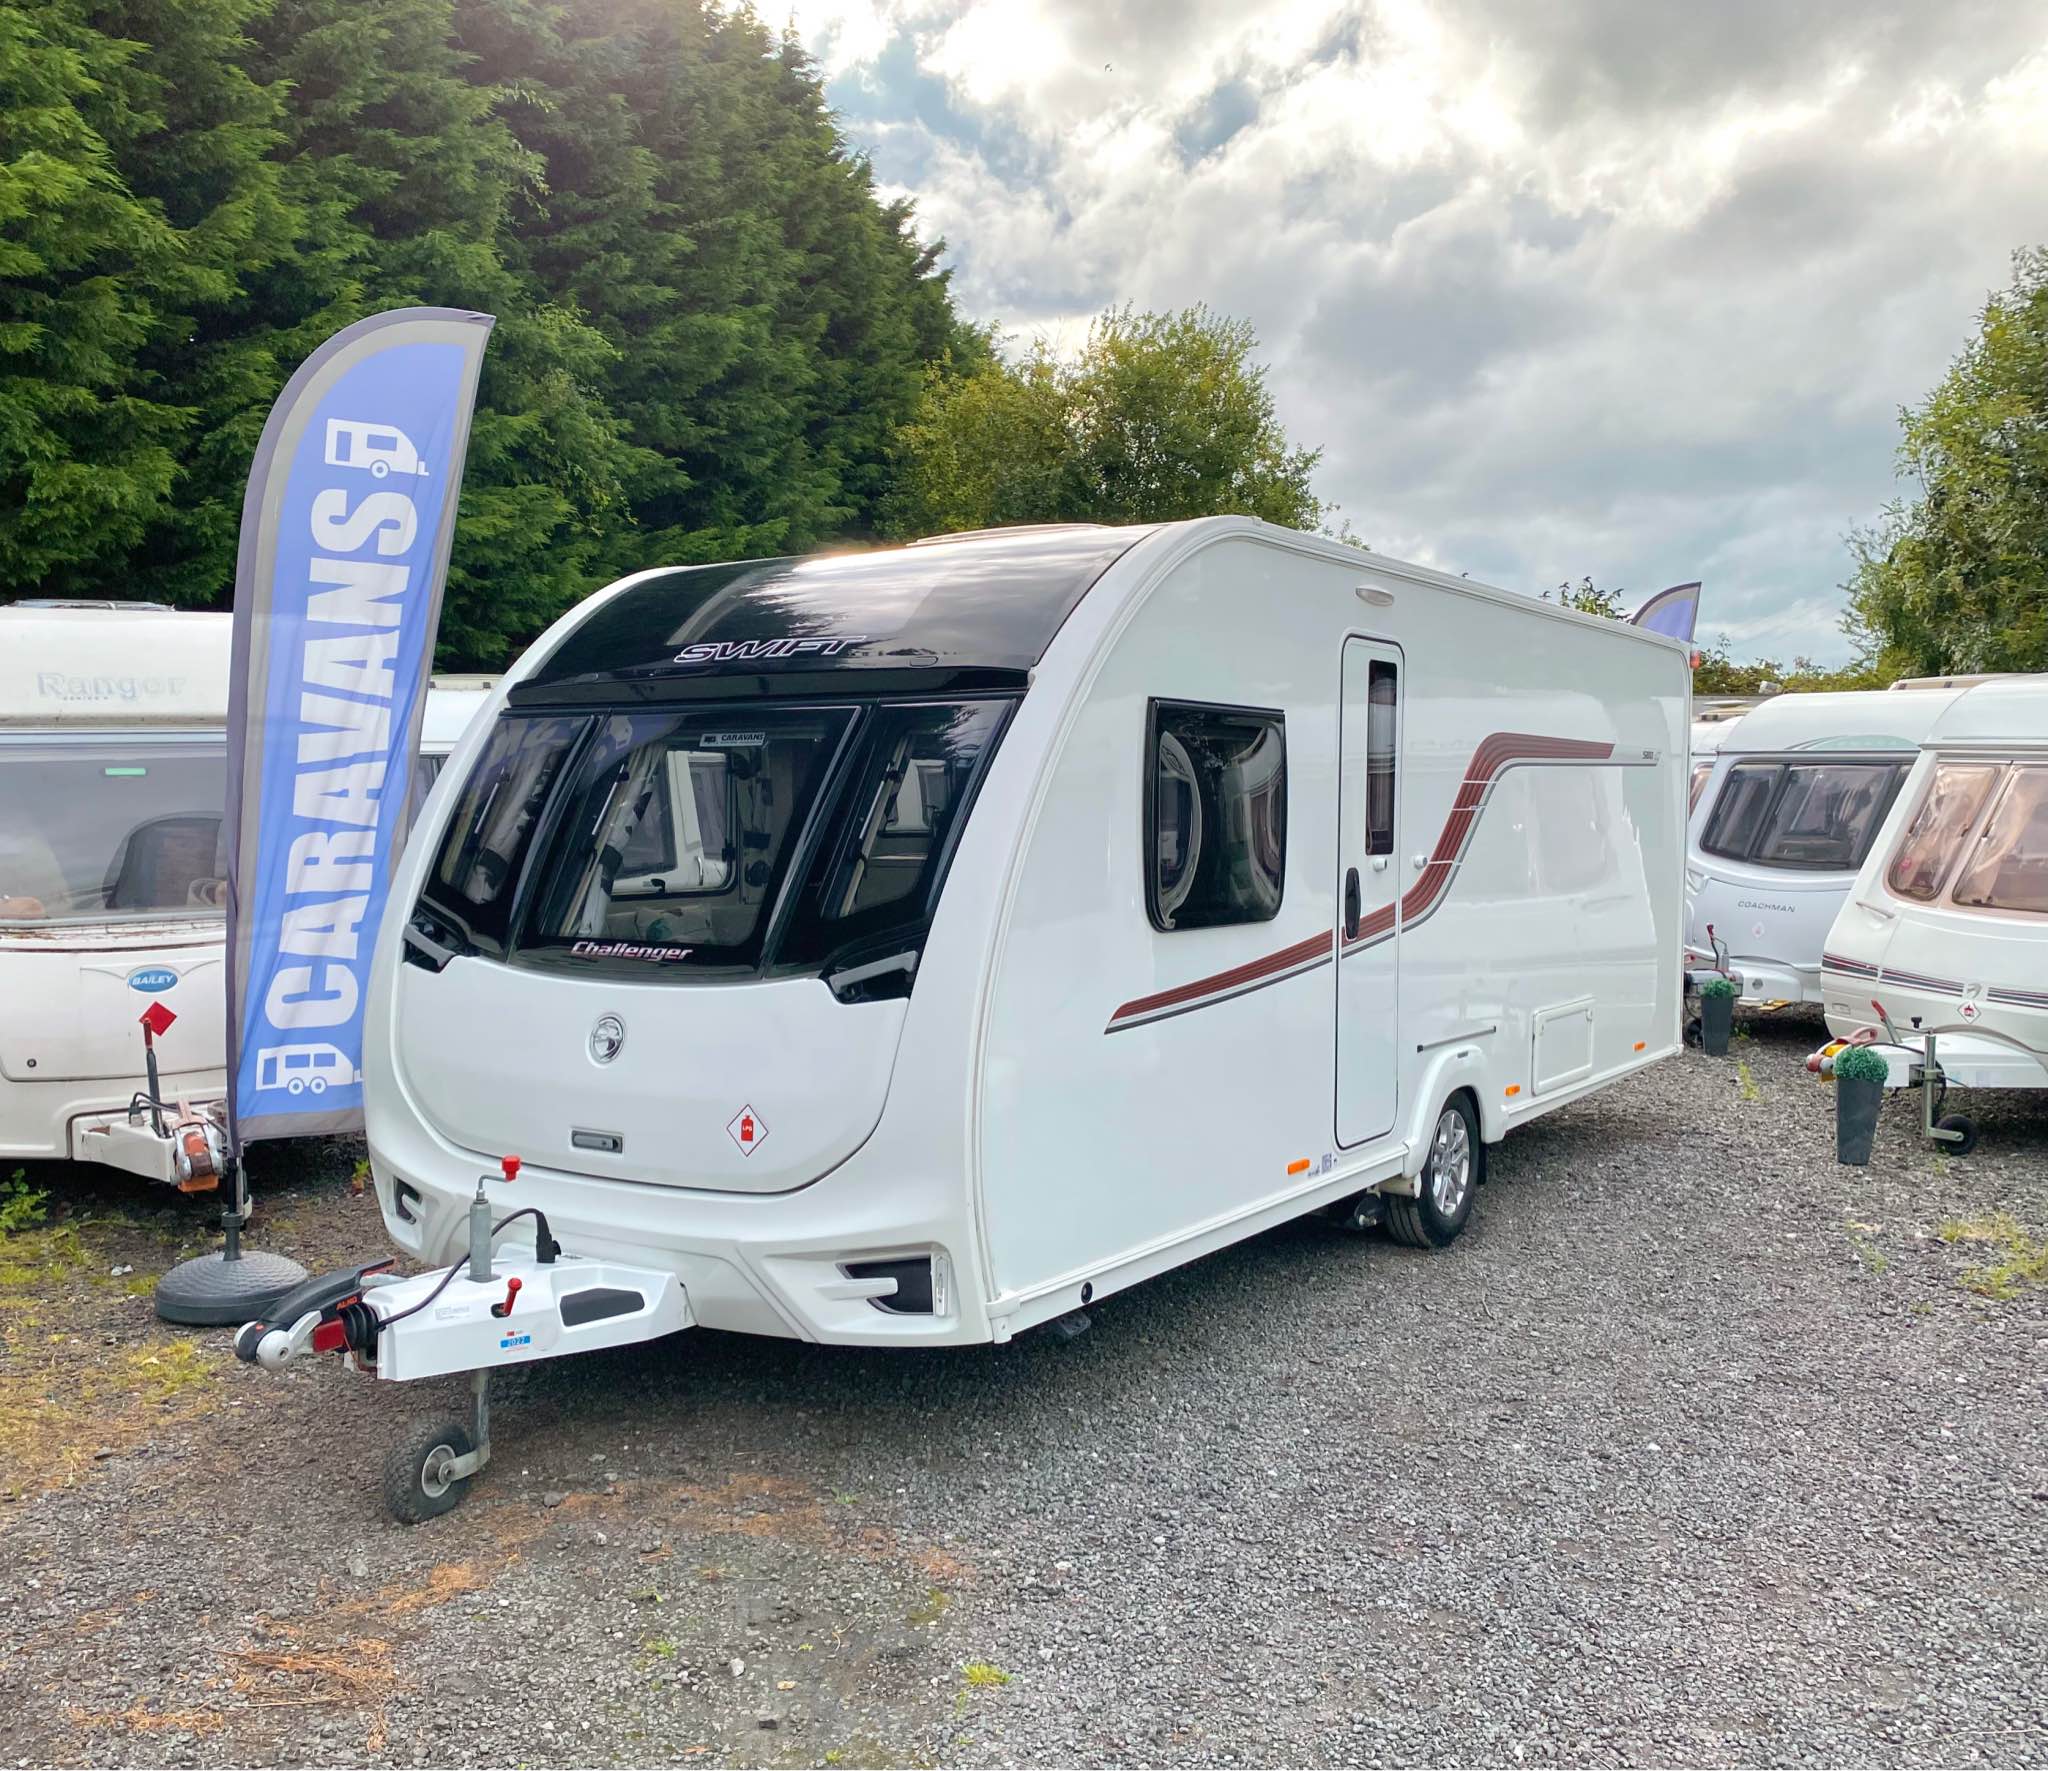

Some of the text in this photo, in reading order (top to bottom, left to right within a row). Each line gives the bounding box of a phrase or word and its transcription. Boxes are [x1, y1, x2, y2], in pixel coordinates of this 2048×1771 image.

[673, 635, 867, 663] SWIFT
[37, 672, 187, 700] Ranger
[264, 488, 418, 1030] CARAVANS
[1737, 900, 1796, 913] COACHMAN
[571, 941, 693, 961] Challenger
[132, 974, 173, 985] BAILEY
